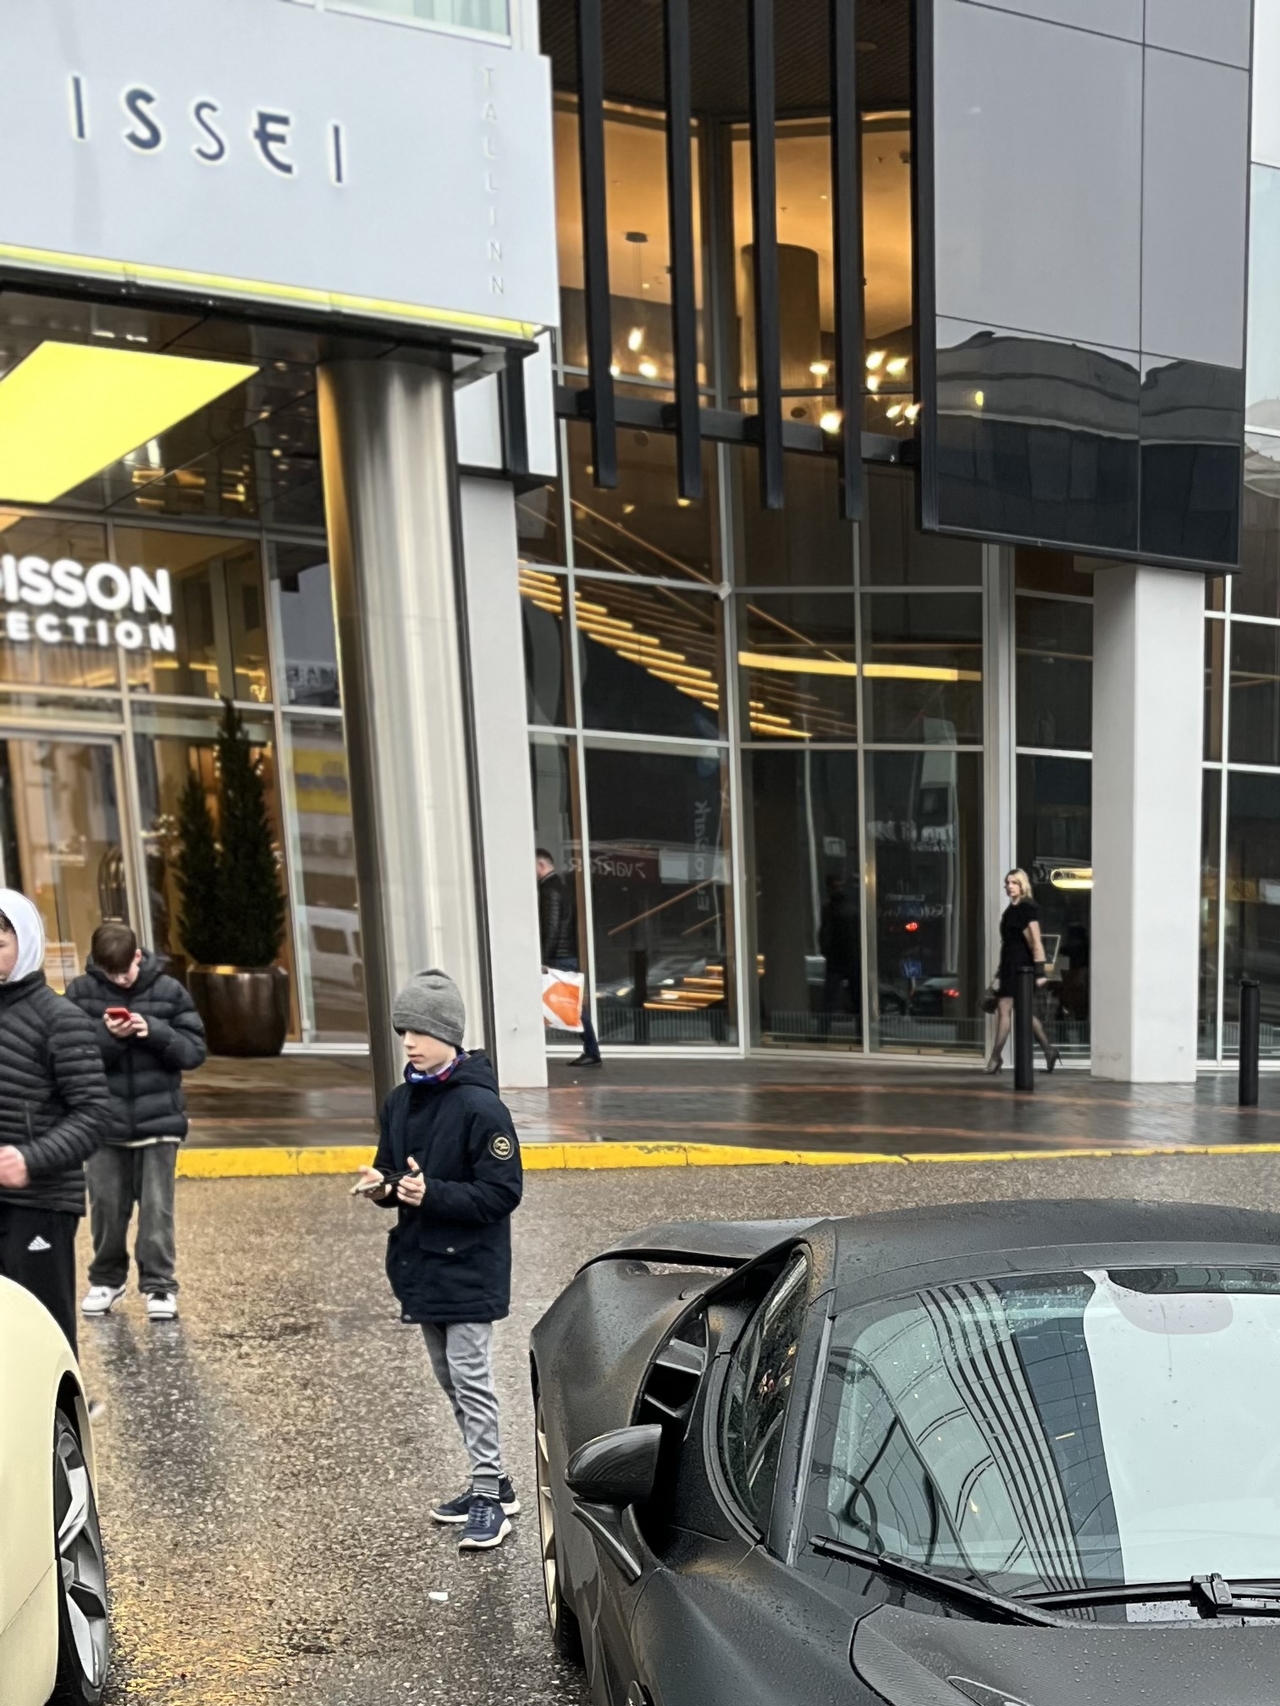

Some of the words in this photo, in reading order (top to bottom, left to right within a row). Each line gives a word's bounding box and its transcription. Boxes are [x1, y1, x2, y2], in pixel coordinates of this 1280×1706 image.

[71, 75, 343, 184] ISSEI
[482, 66, 505, 296] TALLINN
[0, 553, 173, 615] ISSON
[3, 610, 177, 652] ECTION
